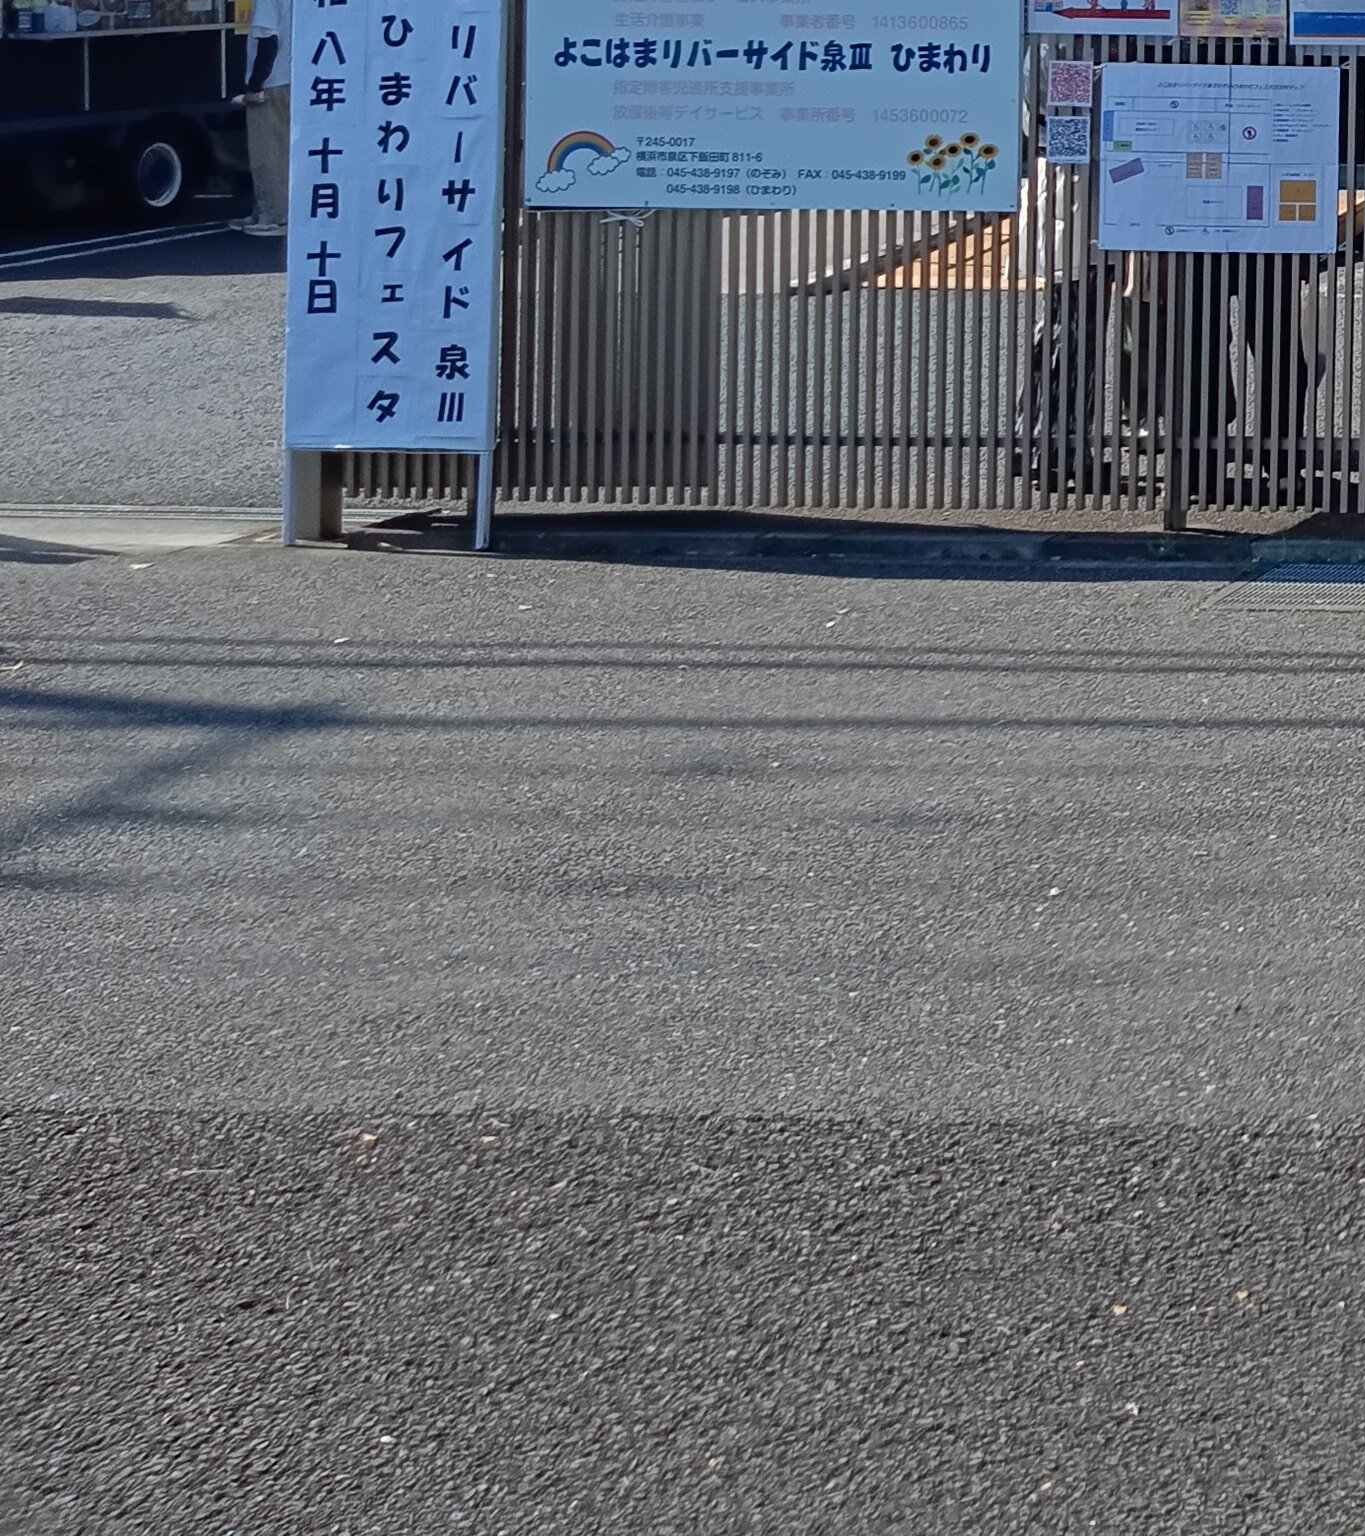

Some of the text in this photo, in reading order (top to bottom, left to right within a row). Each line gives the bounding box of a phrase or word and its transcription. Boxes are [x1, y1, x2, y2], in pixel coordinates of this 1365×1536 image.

[872, 16, 969, 31] 1413600865
[890, 42, 991, 74] ひまわり
[872, 108, 969, 124] 1453600072
